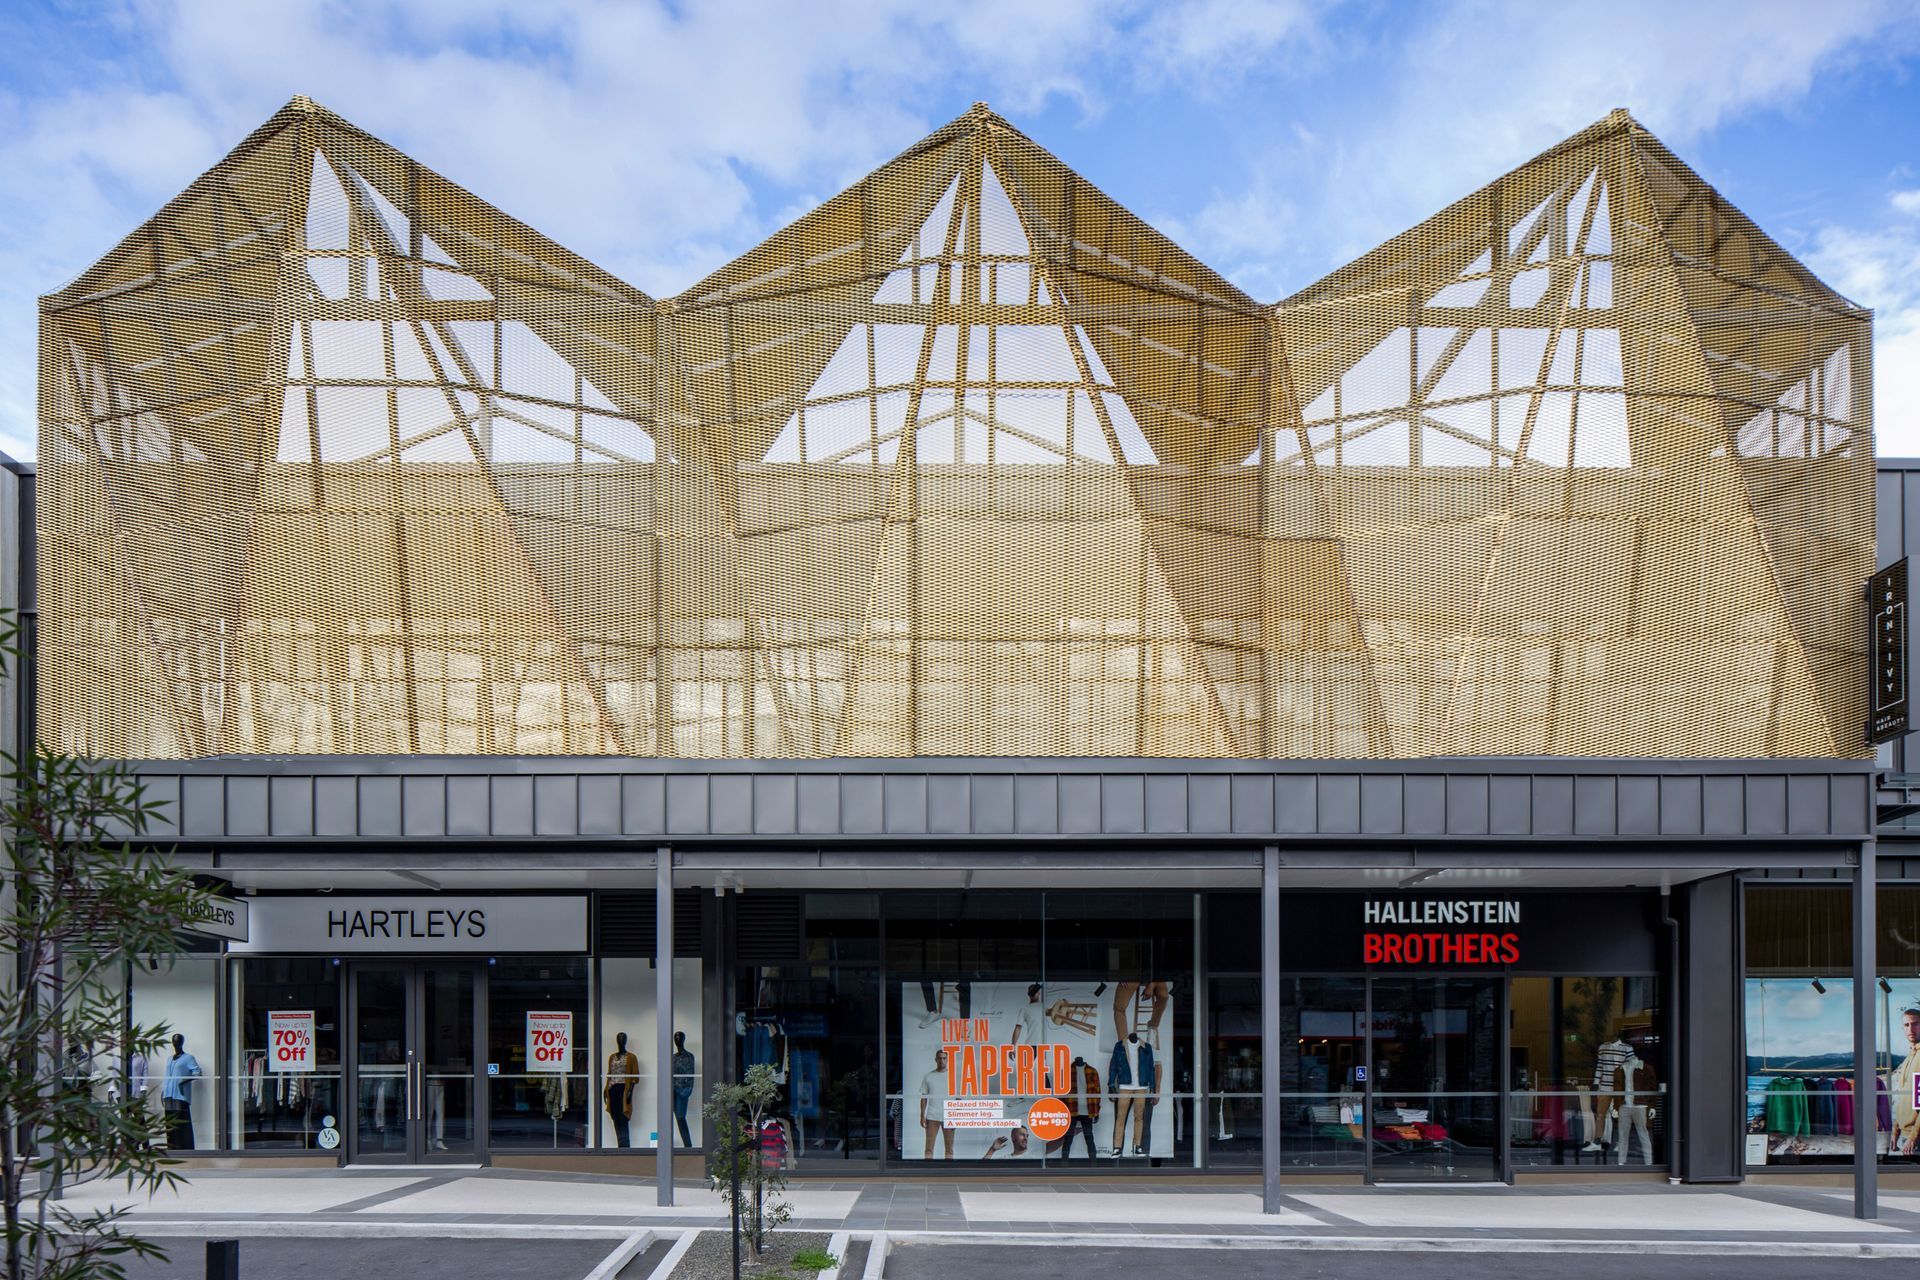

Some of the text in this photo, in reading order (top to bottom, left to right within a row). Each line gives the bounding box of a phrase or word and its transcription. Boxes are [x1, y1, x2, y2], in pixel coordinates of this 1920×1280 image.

[1364, 900, 1520, 924] HALLENSTEIN
[328, 910, 486, 938] HARTLEYS
[1364, 932, 1520, 964] BROTHERS
[274, 1021, 290, 1029] Now
[942, 1019, 989, 1042] LIVE IN
[273, 1029, 311, 1046] 70%
[531, 1030, 568, 1047] 70%
[277, 1047, 306, 1062] Off
[535, 1047, 564, 1062] Off
[943, 1044, 1071, 1096] TAPERED
[978, 1101, 1001, 1109] thigh.
[979, 1111, 995, 1119] leg.
[1030, 1111, 1068, 1119] All Denim
[1030, 1118, 1068, 1127] 2 for $99
[992, 1120, 1018, 1128] staple.
